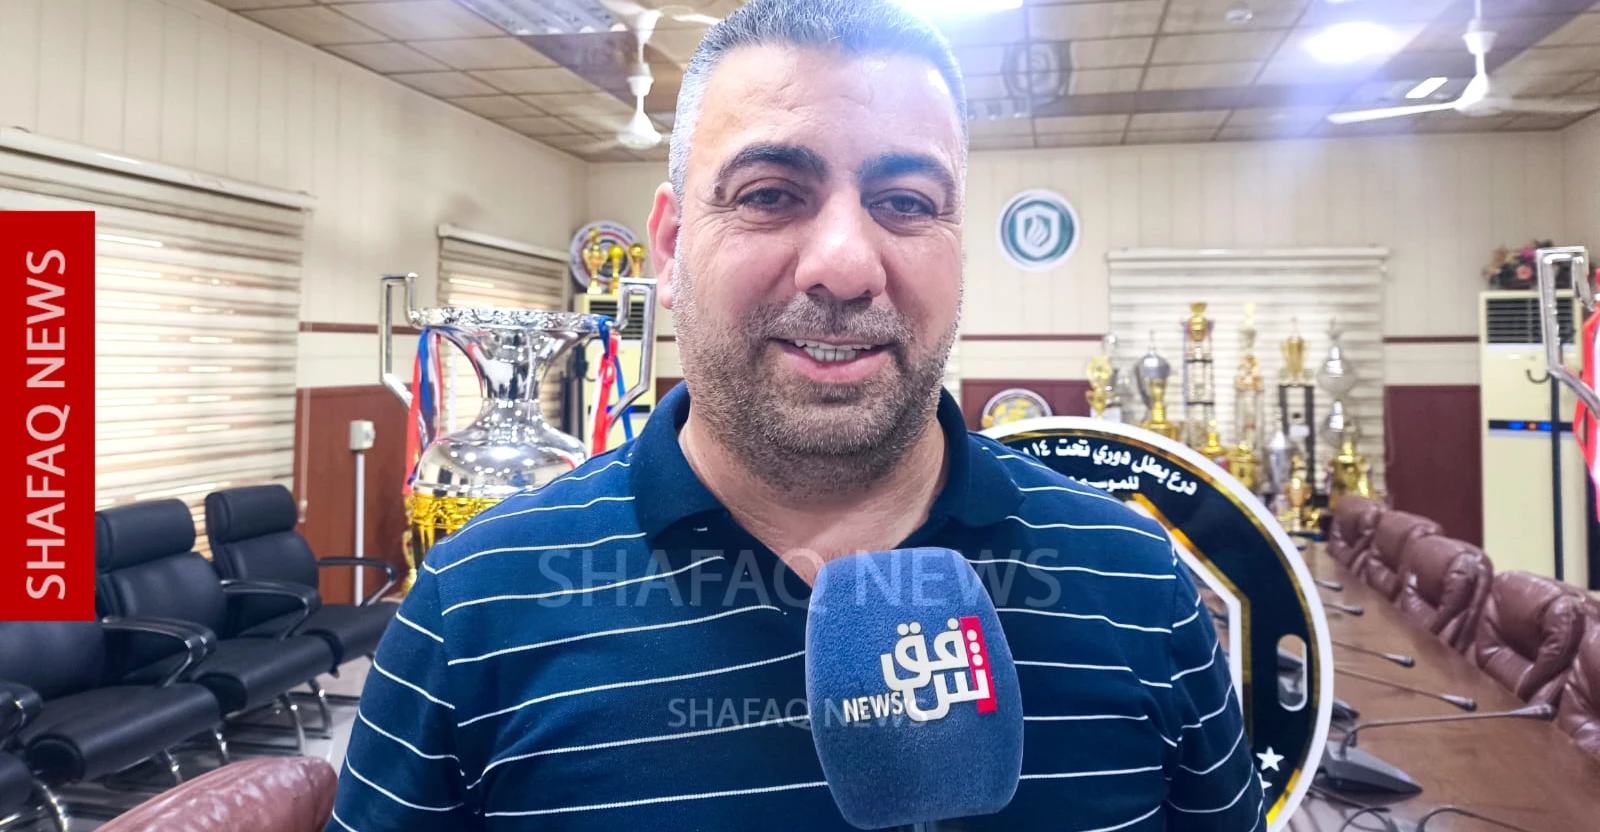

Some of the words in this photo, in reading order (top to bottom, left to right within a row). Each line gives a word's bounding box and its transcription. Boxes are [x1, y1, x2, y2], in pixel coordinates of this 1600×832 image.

[1055, 438, 1091, 457] تحت
[1092, 445, 1132, 466] دوري
[1131, 454, 1170, 484] بطل
[1166, 471, 1197, 496] درع
[843, 691, 903, 723] NEWS
